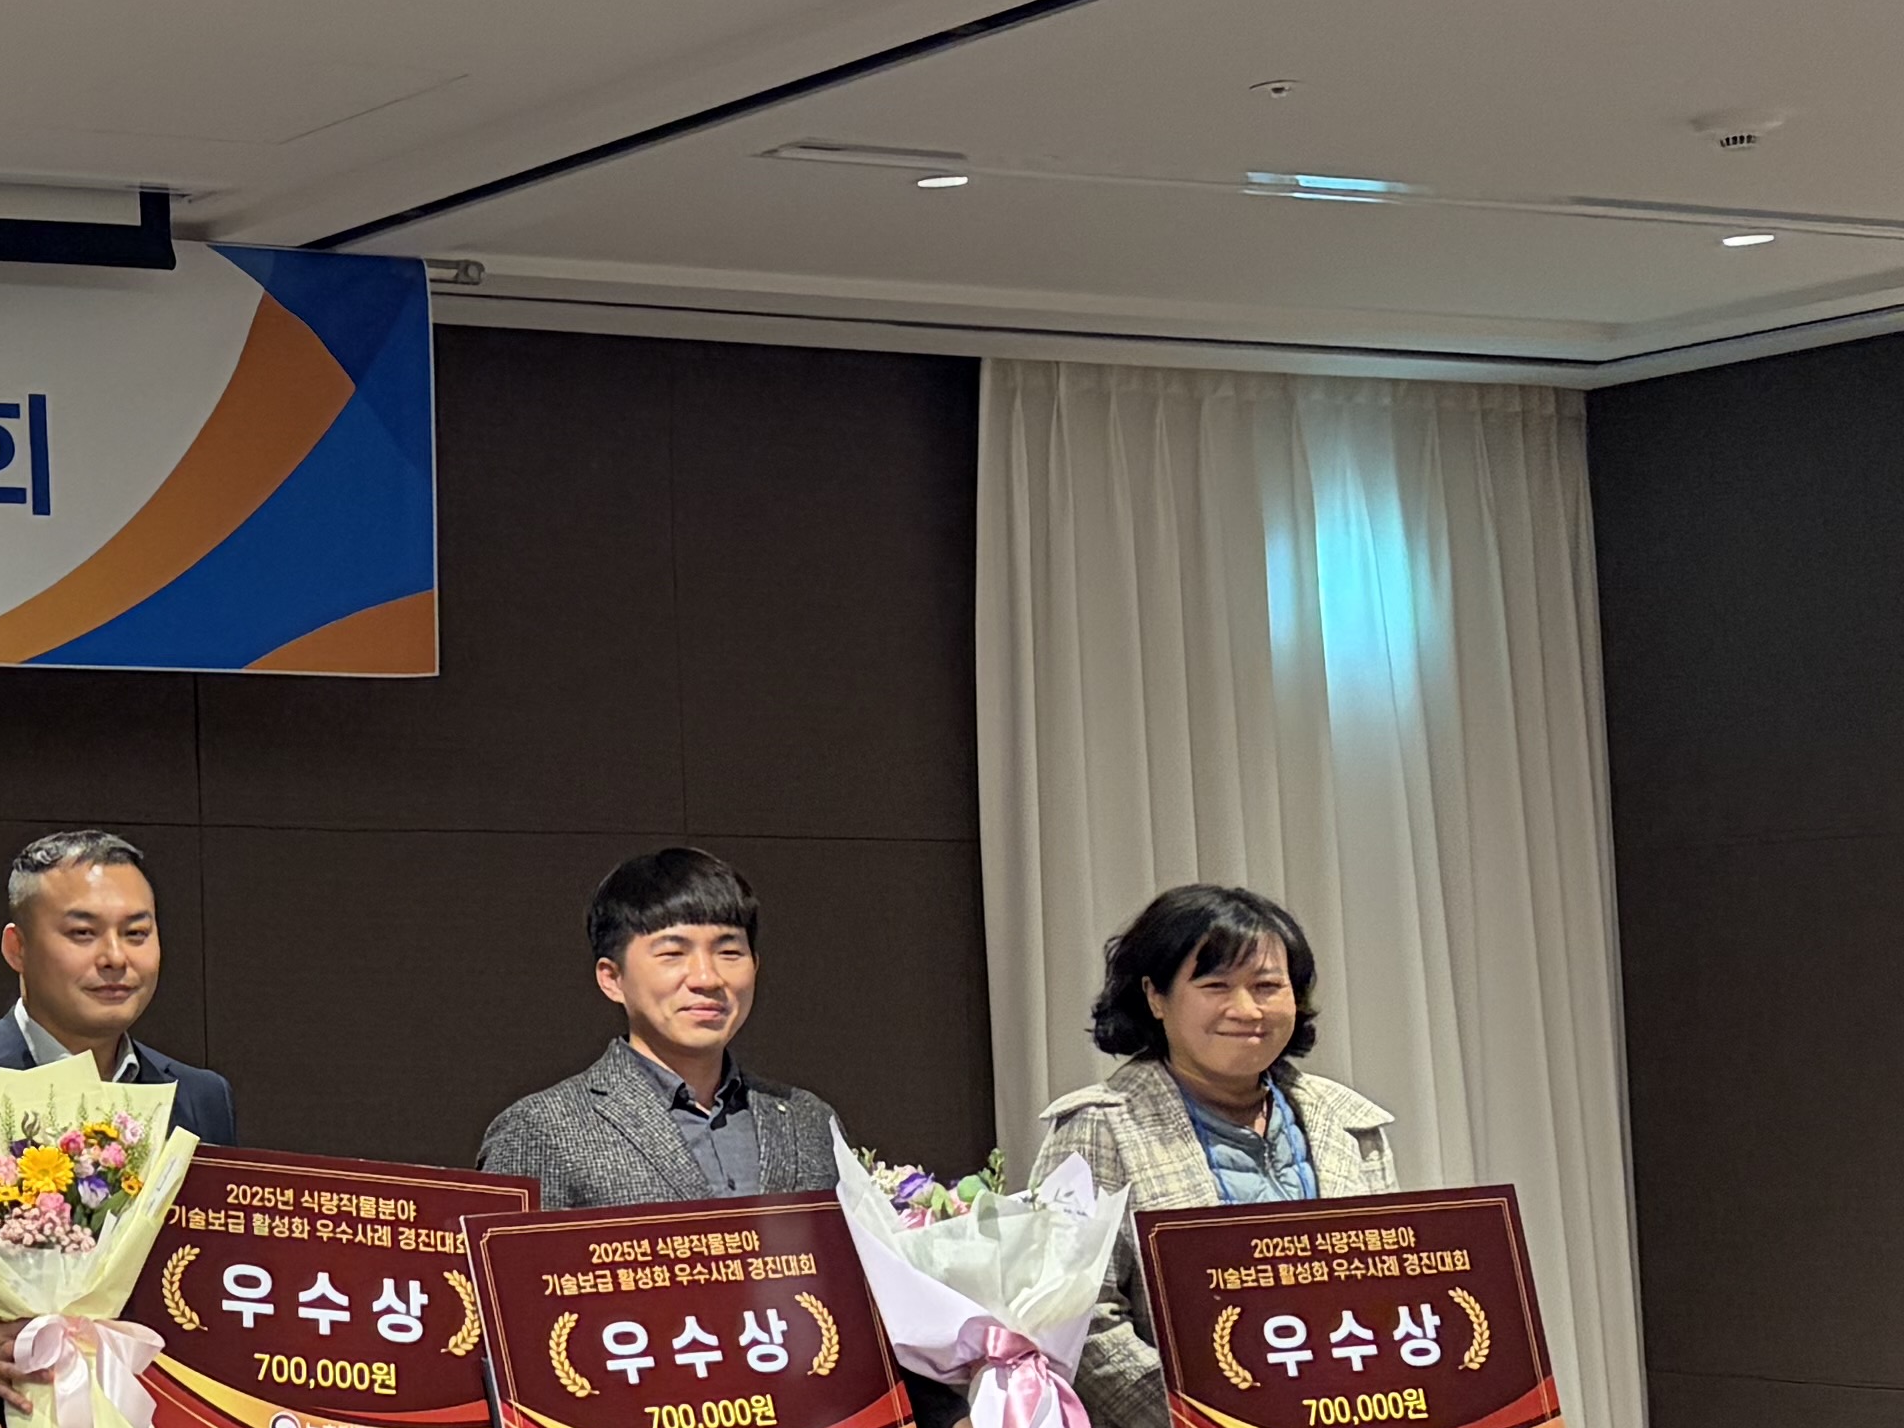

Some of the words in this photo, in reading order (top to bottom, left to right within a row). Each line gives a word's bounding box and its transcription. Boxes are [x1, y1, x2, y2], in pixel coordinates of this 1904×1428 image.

[226, 1183, 295, 1211] 2025년
[299, 1189, 417, 1223] 식량작물분야
[168, 1204, 246, 1234] 기술보급
[251, 1212, 310, 1240] 활성화
[315, 1221, 392, 1248] 우수사례
[1250, 1234, 1312, 1259] 2025년
[1315, 1226, 1416, 1254] 식량작물분야
[588, 1238, 653, 1264] 2025년
[656, 1229, 760, 1260] 식량작물분야
[542, 1268, 614, 1296] 기술보급
[616, 1265, 671, 1292] 활성화
[674, 1259, 745, 1286] 우수사례
[746, 1252, 817, 1281] 경진대회
[1206, 1264, 1275, 1290] 기술보급
[1278, 1261, 1329, 1285] 활성화
[1332, 1255, 1400, 1281] 우수사례
[1402, 1249, 1472, 1276] 경진대회
[253, 1352, 397, 1395] 700,000원
[1302, 1387, 1429, 1426] 700,000원
